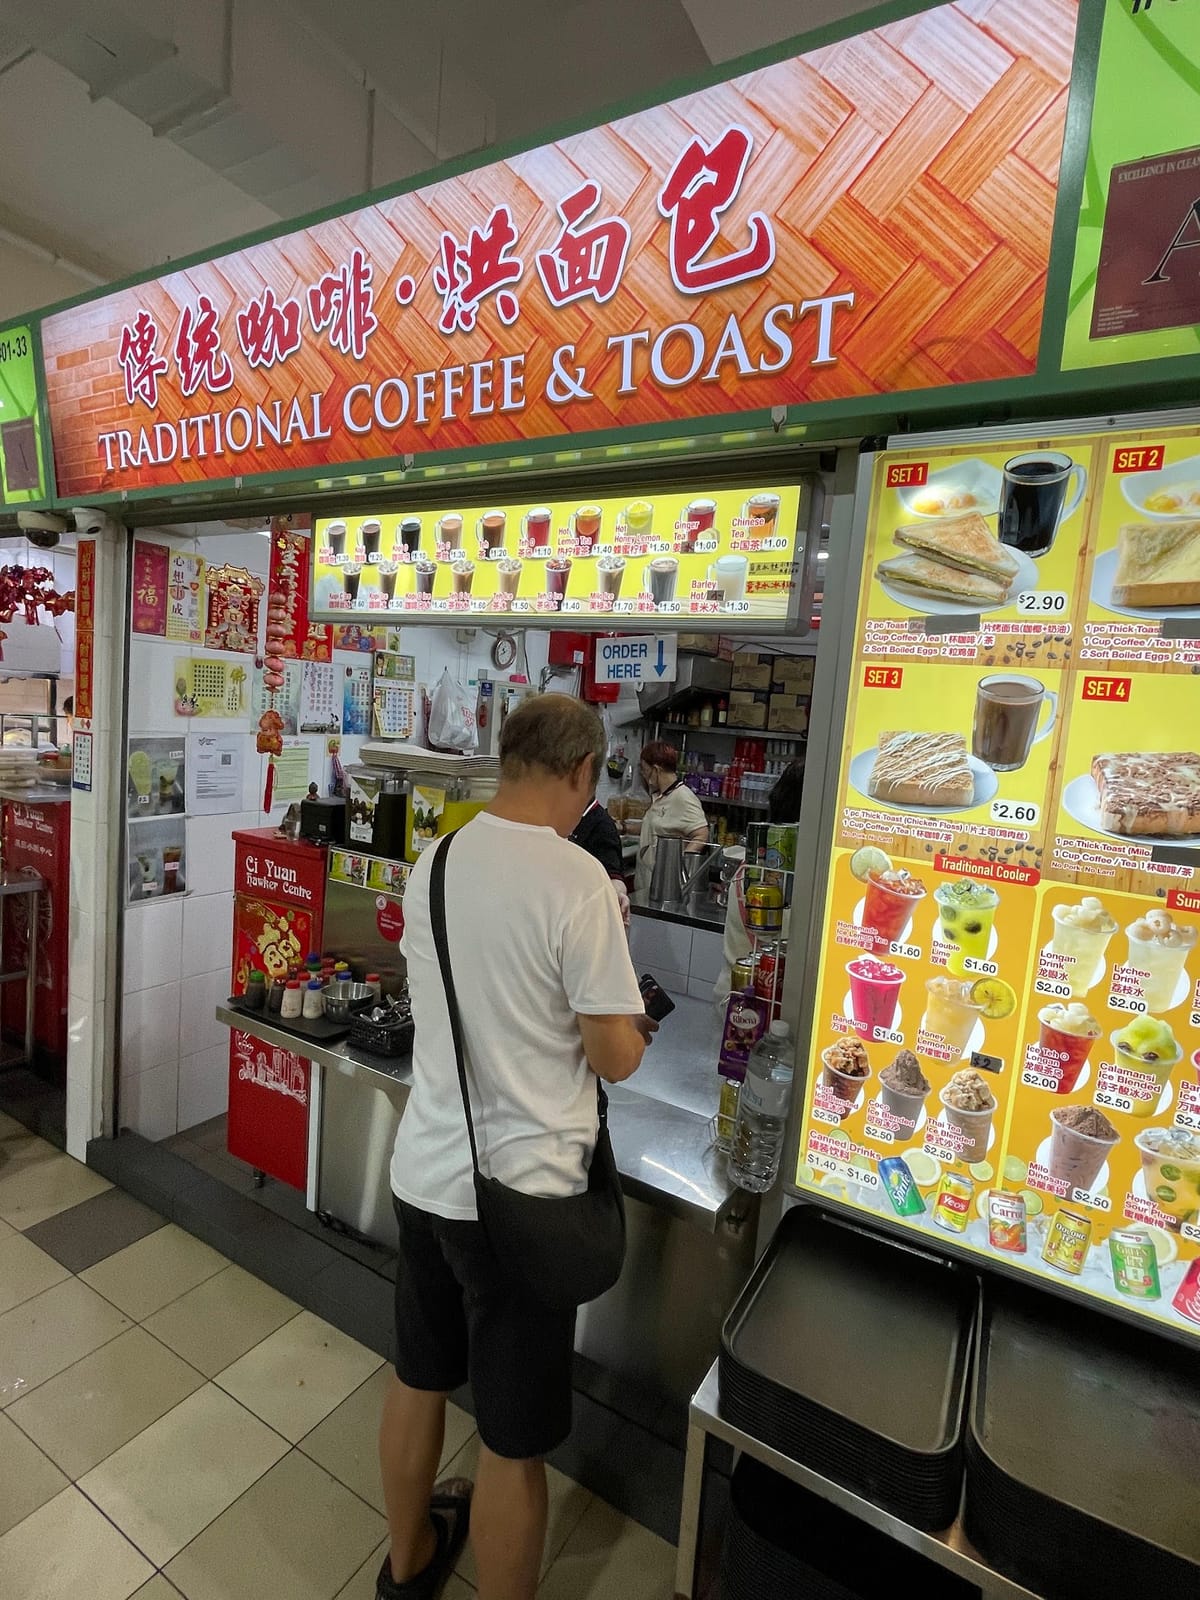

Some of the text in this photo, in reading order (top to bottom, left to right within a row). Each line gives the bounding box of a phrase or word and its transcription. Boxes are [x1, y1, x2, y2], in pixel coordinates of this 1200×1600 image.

[1118, 162, 1166, 184] EXCELLENCE
[0, 335, 28, 363] 01-33
[98, 292, 855, 471] TRADITIONAL COFFEE & TOAST
[1117, 449, 1159, 469] SET 2
[890, 465, 925, 483] SET 1
[674, 521, 700, 531] Ginger
[732, 518, 765, 527] Chinese
[674, 532, 686, 540] Tea
[732, 530, 745, 538] Tea
[696, 541, 717, 550] $1.00
[765, 539, 787, 548] $1.00
[691, 580, 717, 589] Barley
[727, 602, 749, 611] $1.30
[1018, 594, 1065, 612] $2.90
[867, 621, 872, 629] 2
[874, 623, 884, 631] pc
[886, 621, 908, 629] Toast
[1093, 626, 1105, 634] pc
[1108, 625, 1134, 633] Thick
[872, 634, 889, 643] Cup
[892, 634, 918, 642] Coffee
[1092, 638, 1111, 647] Cup
[1114, 638, 1145, 646] Coffee
[603, 643, 648, 660] ORDER
[864, 645, 938, 656] 2 Soft Boiled Eggs
[1090, 650, 1110, 658] Soft
[1112, 651, 1142, 659] Boiled
[1145, 652, 1170, 661] Eggs
[607, 664, 642, 679] HERE
[868, 671, 899, 686] SET 3
[1087, 680, 1126, 698] SET 4
[993, 802, 1036, 821] $2.60
[849, 821, 864, 829] Cup
[865, 823, 890, 832] Coffee
[861, 812, 880, 820] Thick
[883, 814, 902, 822] Toast
[904, 817, 937, 828] (Chicken
[1062, 840, 1152, 857] pc Thick Toast (Milo
[1062, 851, 1137, 868] Cup Coffee Tea
[245, 855, 297, 883] Ci Yuan
[941, 857, 1031, 882] Traditional Cooler
[283, 881, 312, 900] Centre
[837, 921, 878, 934] Homemade
[849, 931, 873, 942] Lemon
[891, 943, 920, 957] $1.60
[931, 948, 951, 958] Lime
[932, 940, 960, 951] Double
[1039, 958, 1065, 970] Drink
[1040, 950, 1076, 963] Longan
[964, 958, 997, 974] $1.60
[1113, 964, 1151, 979] Lychee
[1112, 973, 1140, 985] Drink
[1036, 981, 1070, 996] $2.00
[1109, 996, 1147, 1013] $2.00
[832, 1014, 868, 1029] Bandung
[874, 1028, 903, 1043] $1.60
[918, 1029, 945, 1042] Honey
[917, 1037, 960, 1053] Lemon Ice
[1027, 1045, 1040, 1054] Ice
[1043, 1048, 1059, 1058] Teh
[1026, 1053, 1060, 1067] Longan
[1100, 1062, 1155, 1082] Calamansi
[1023, 1073, 1057, 1089] $2.00
[1098, 1070, 1161, 1092] Ice Blended
[1096, 1092, 1131, 1109] $2.50
[1179, 1091, 1197, 1102] Ice
[868, 1099, 890, 1111] Coco
[813, 1109, 839, 1124] $2.50
[867, 1107, 915, 1127] Ice Blended
[927, 1117, 961, 1133] Thai Tea
[865, 1126, 892, 1141] $2.50
[926, 1126, 975, 1146] Ice Blended
[809, 1130, 882, 1161] Canned Drinks
[924, 1144, 953, 1161] $2.50
[808, 1154, 878, 1186] $1.40 $1.60
[1029, 1162, 1049, 1174] Milo
[1028, 1169, 1070, 1187] Dinosaur
[1074, 1190, 1109, 1209] $2.50
[1126, 1193, 1157, 1208] Honey
[1125, 1201, 1176, 1222] Sour Plum
